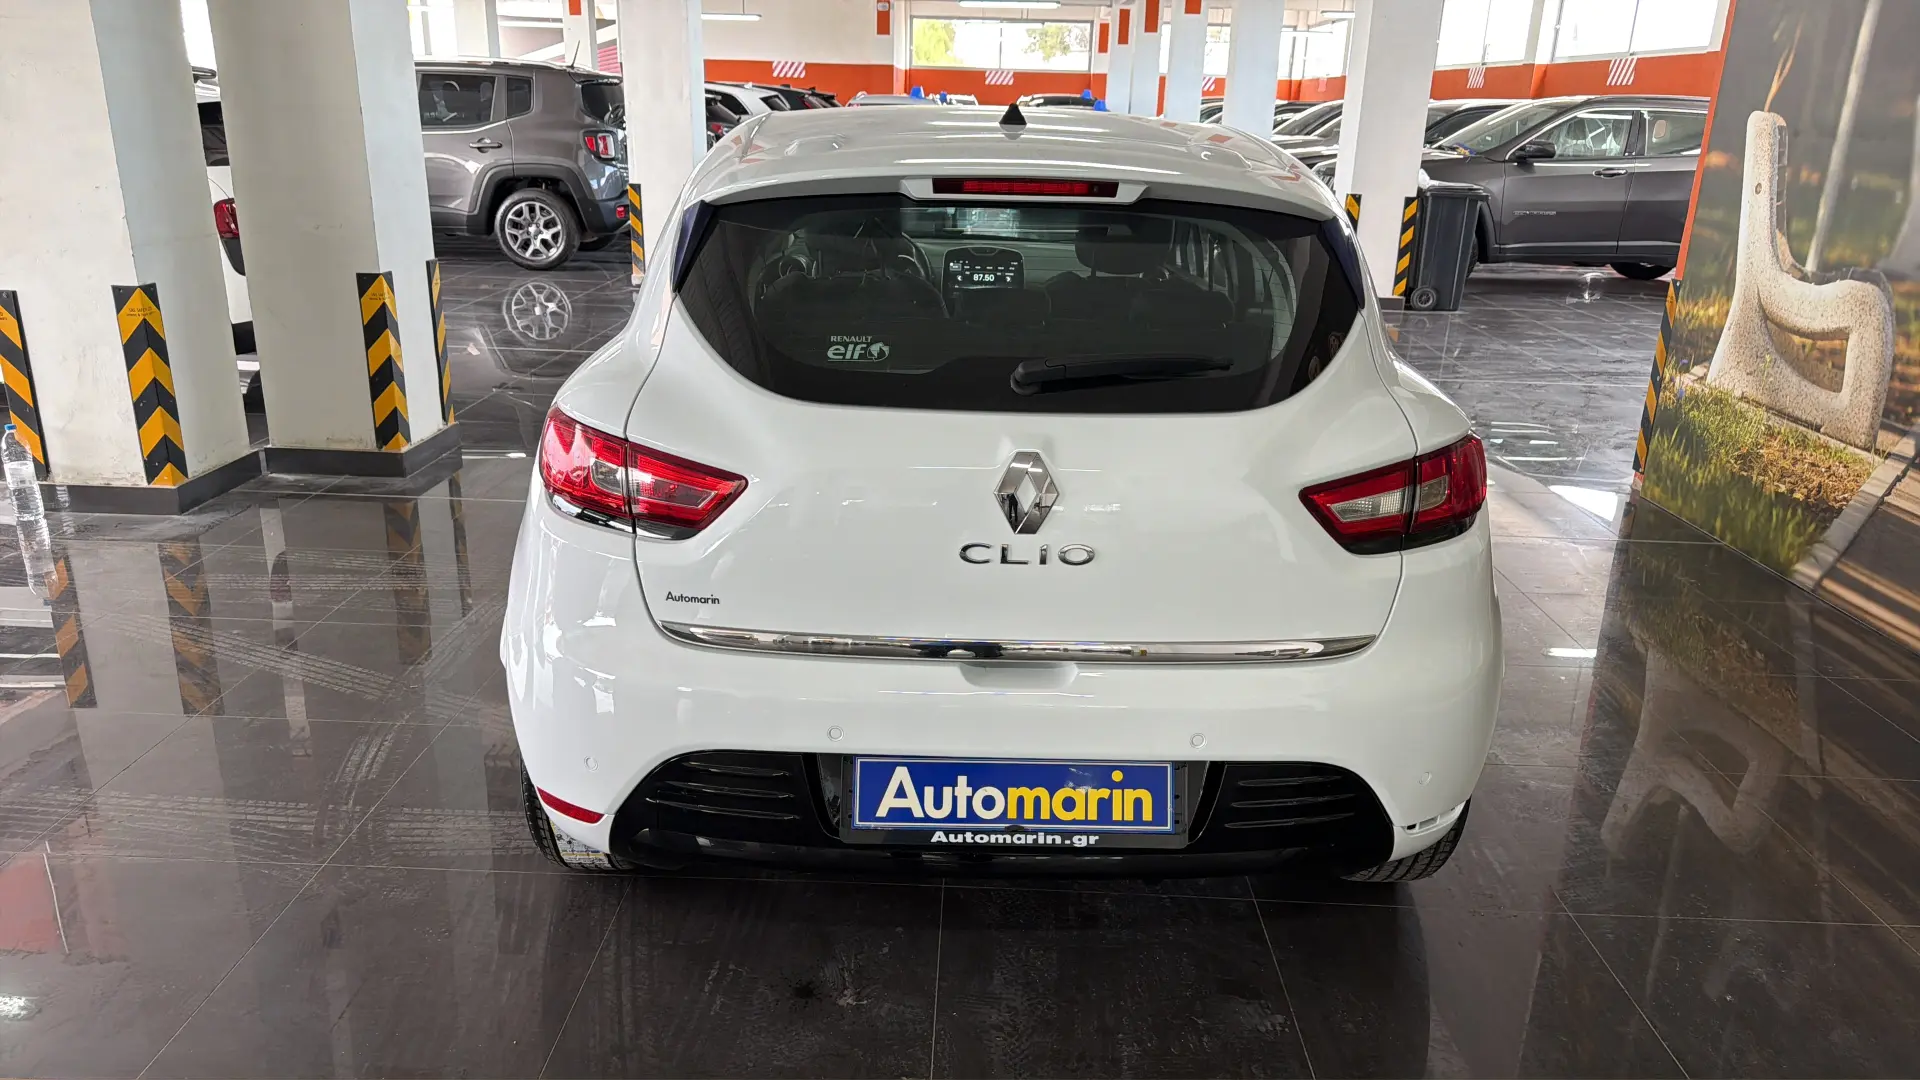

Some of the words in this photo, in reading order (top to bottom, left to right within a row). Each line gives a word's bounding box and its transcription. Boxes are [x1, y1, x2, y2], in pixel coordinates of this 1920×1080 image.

[973, 273, 995, 282] 87.50
[830, 335, 873, 343] RENAULT
[827, 343, 867, 360] elf
[959, 542, 1095, 566] CLIO
[665, 591, 720, 604] Automarin
[875, 766, 1153, 821] Automarin
[930, 830, 1099, 847] Automarin.gr
